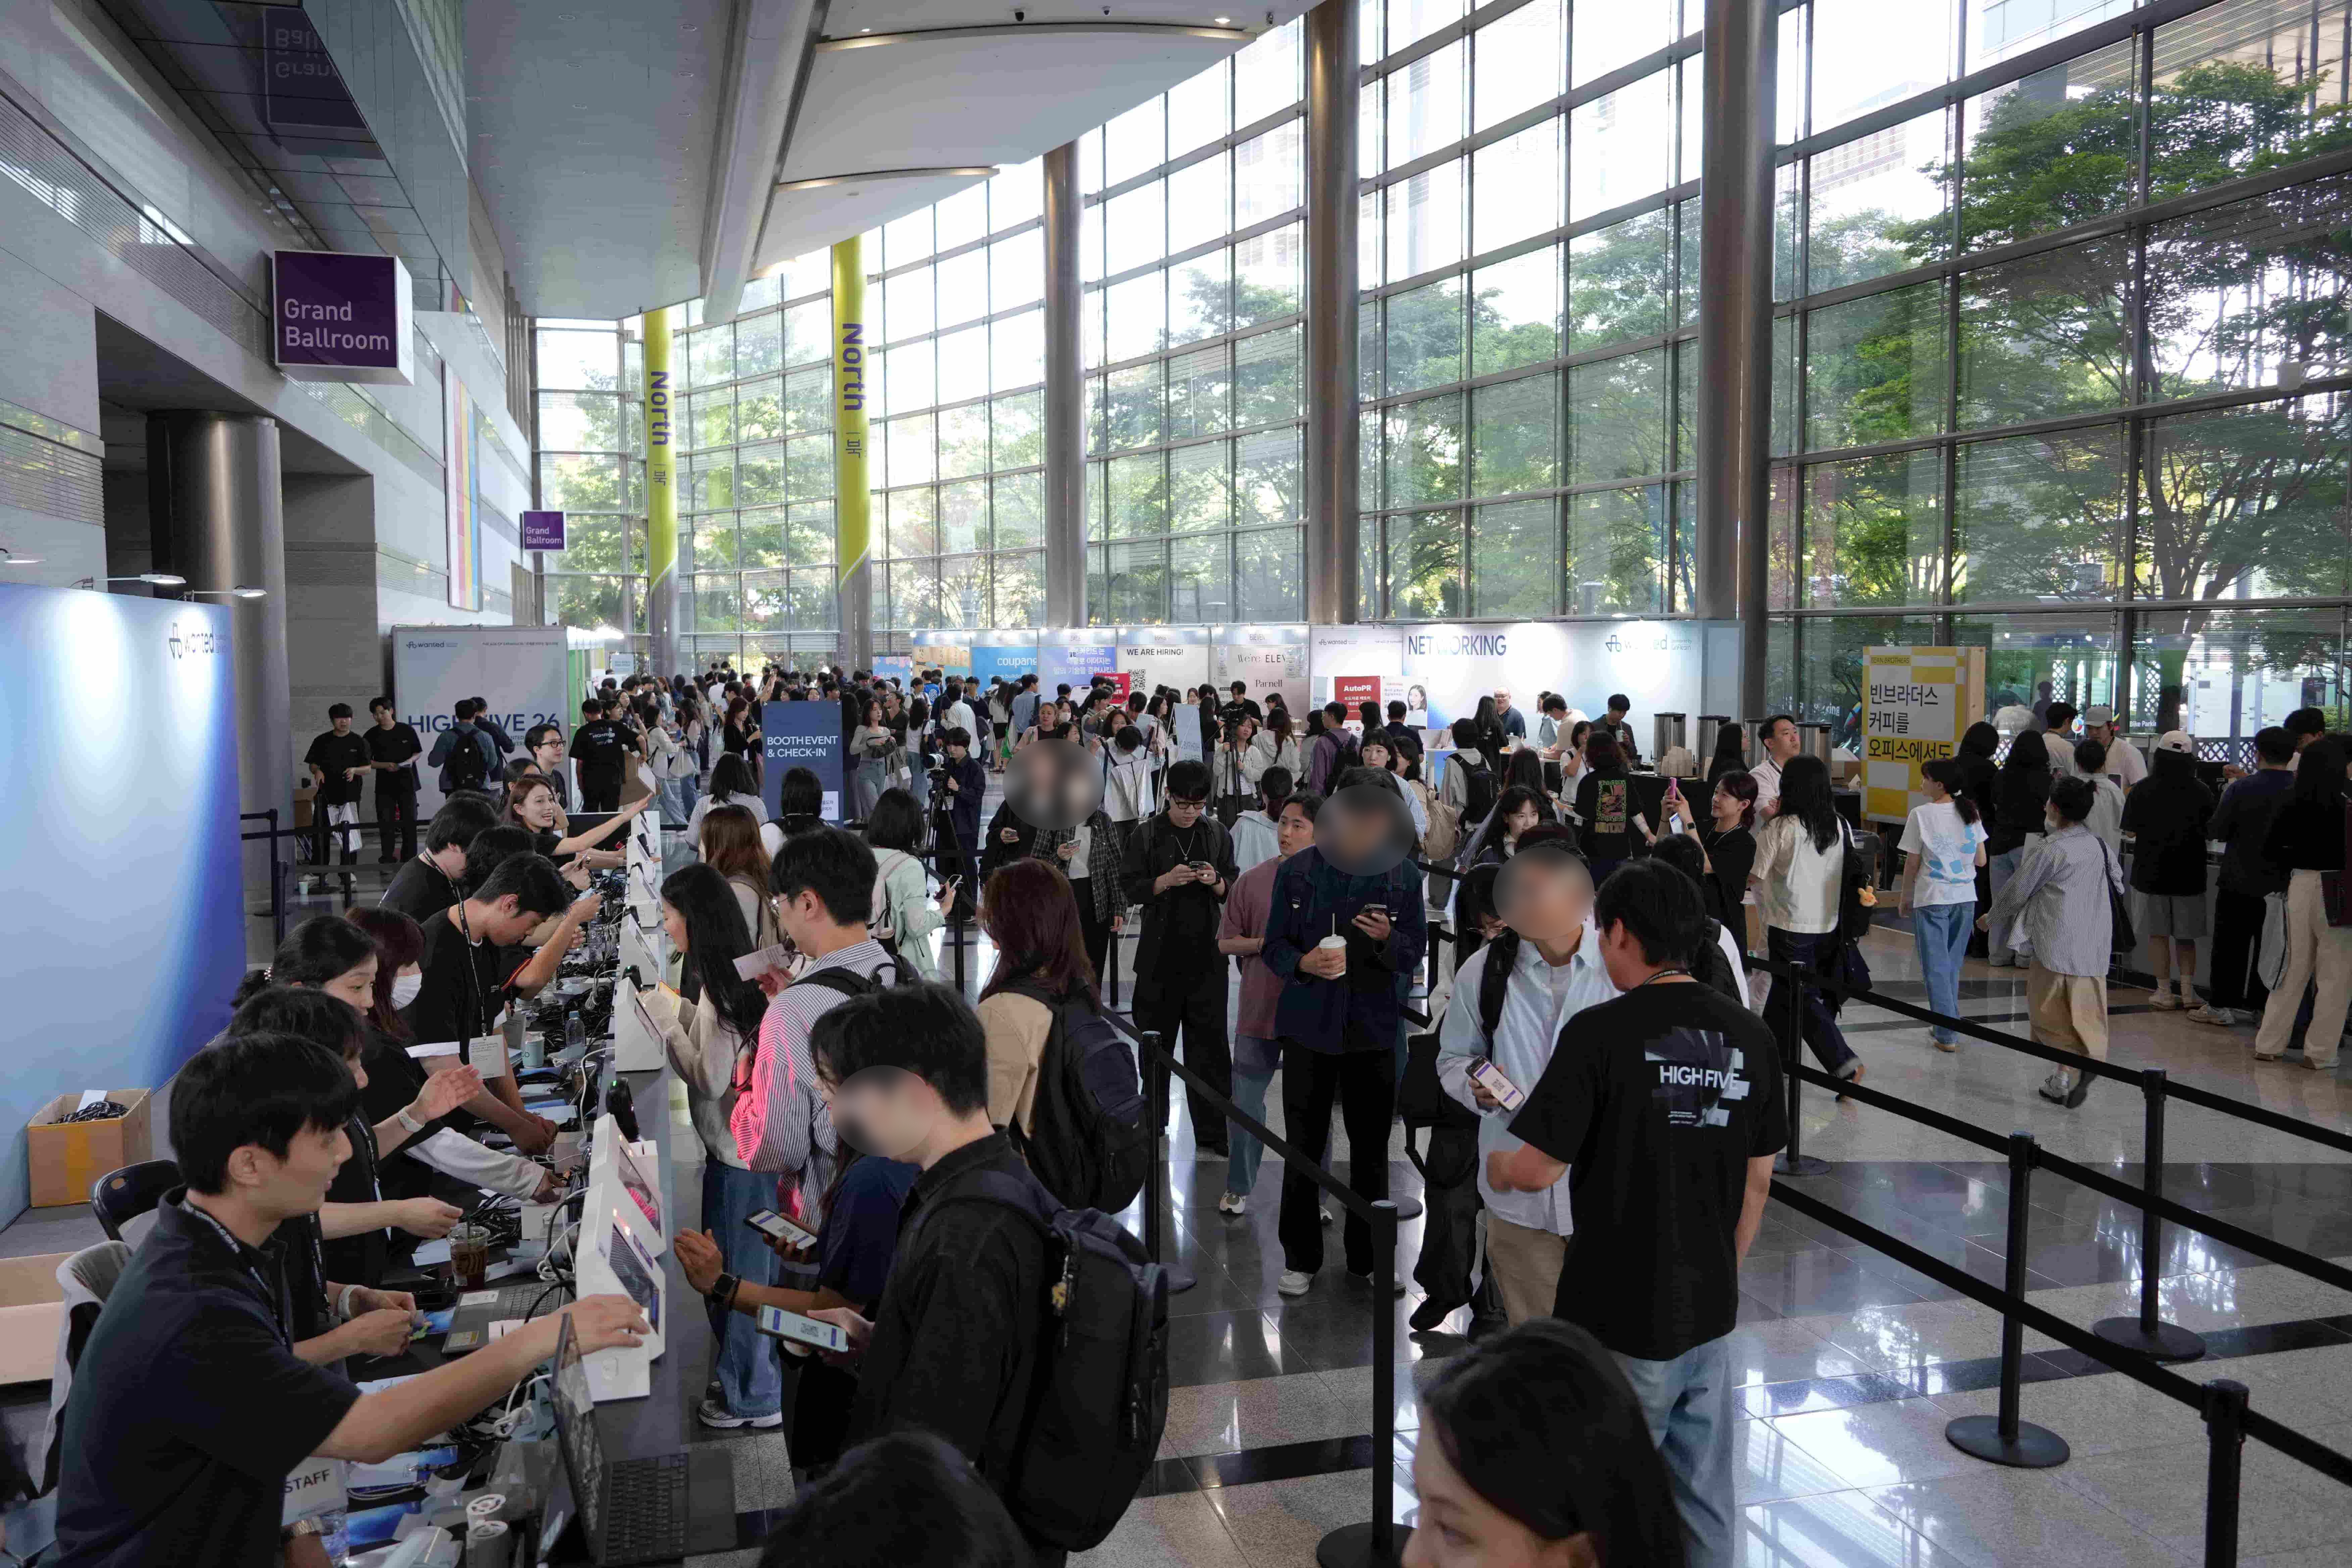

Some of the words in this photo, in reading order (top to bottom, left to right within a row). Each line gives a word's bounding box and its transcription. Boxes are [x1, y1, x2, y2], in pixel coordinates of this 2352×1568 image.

[285, 298, 352, 322] Grand
[286, 326, 389, 350] Ballroom
[842, 323, 866, 411] North
[651, 371, 672, 446] North
[526, 526, 550, 535] Grand
[526, 536, 562, 544] Ballroom
[1409, 635, 1507, 656] NETORKING
[1624, 634, 1668, 650] wed
[1237, 653, 1260, 663] We're
[1266, 655, 1286, 663] ELEV
[1255, 679, 1283, 687] Parnell
[1870, 684, 1939, 707] 빈브라더스
[1869, 711, 1909, 734] 커피를
[767, 737, 803, 745] BOOTH
[805, 735, 838, 745] EVENT
[1869, 739, 1951, 763] 오피스에서도
[767, 749, 775, 757] &
[777, 748, 826, 757] CHECK-IN
[1659, 1065, 1703, 1086] HIGH
[1705, 1069, 1740, 1090] FIVE
[285, 1469, 330, 1493] STAFF
